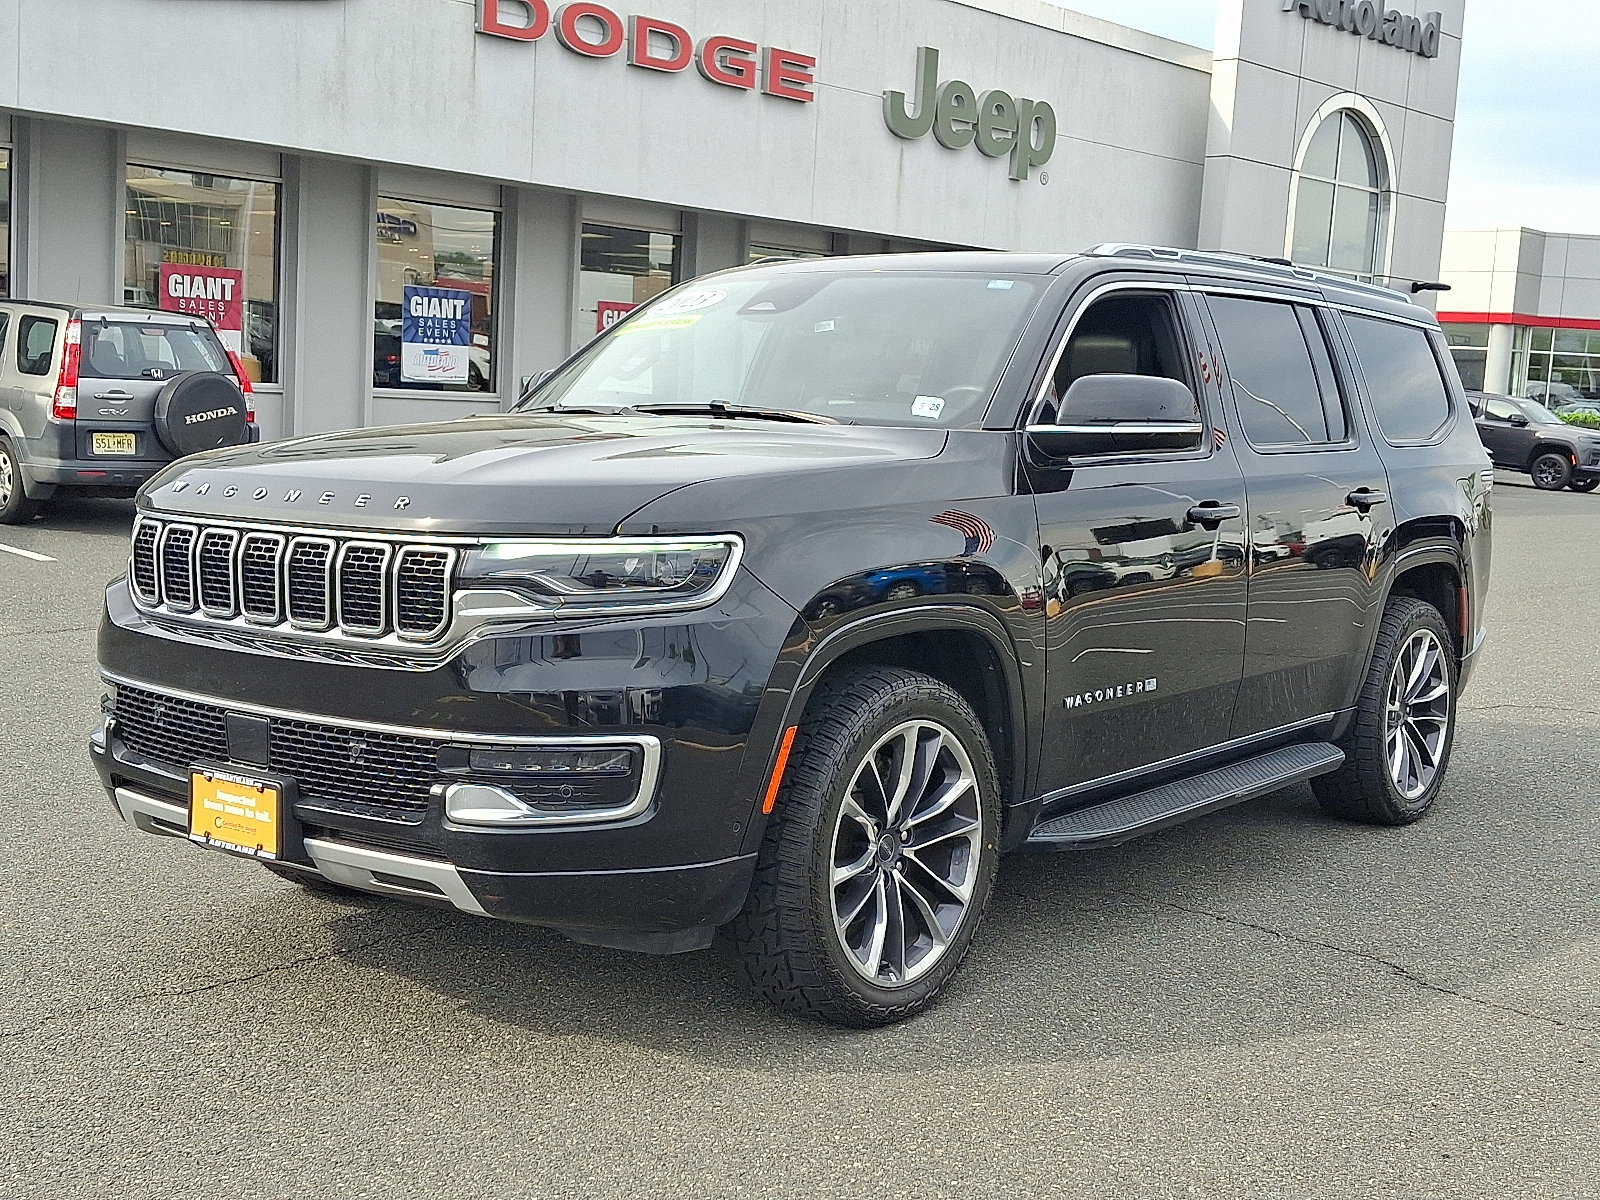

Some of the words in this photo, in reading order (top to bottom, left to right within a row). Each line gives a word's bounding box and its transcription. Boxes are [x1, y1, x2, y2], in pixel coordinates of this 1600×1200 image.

[475, 0, 817, 102] DODGE
[883, 46, 1057, 181] Jeep
[168, 273, 235, 301] GIANT
[179, 299, 225, 311] SALES
[410, 295, 465, 320] GIANT
[418, 318, 456, 328] SALES
[418, 327, 456, 338] EVENT
[98, 408, 129, 416] CR-V
[184, 406, 238, 425] HONDA
[170, 480, 411, 510] WAGONEER
[1064, 682, 1143, 708] WAGONEER
